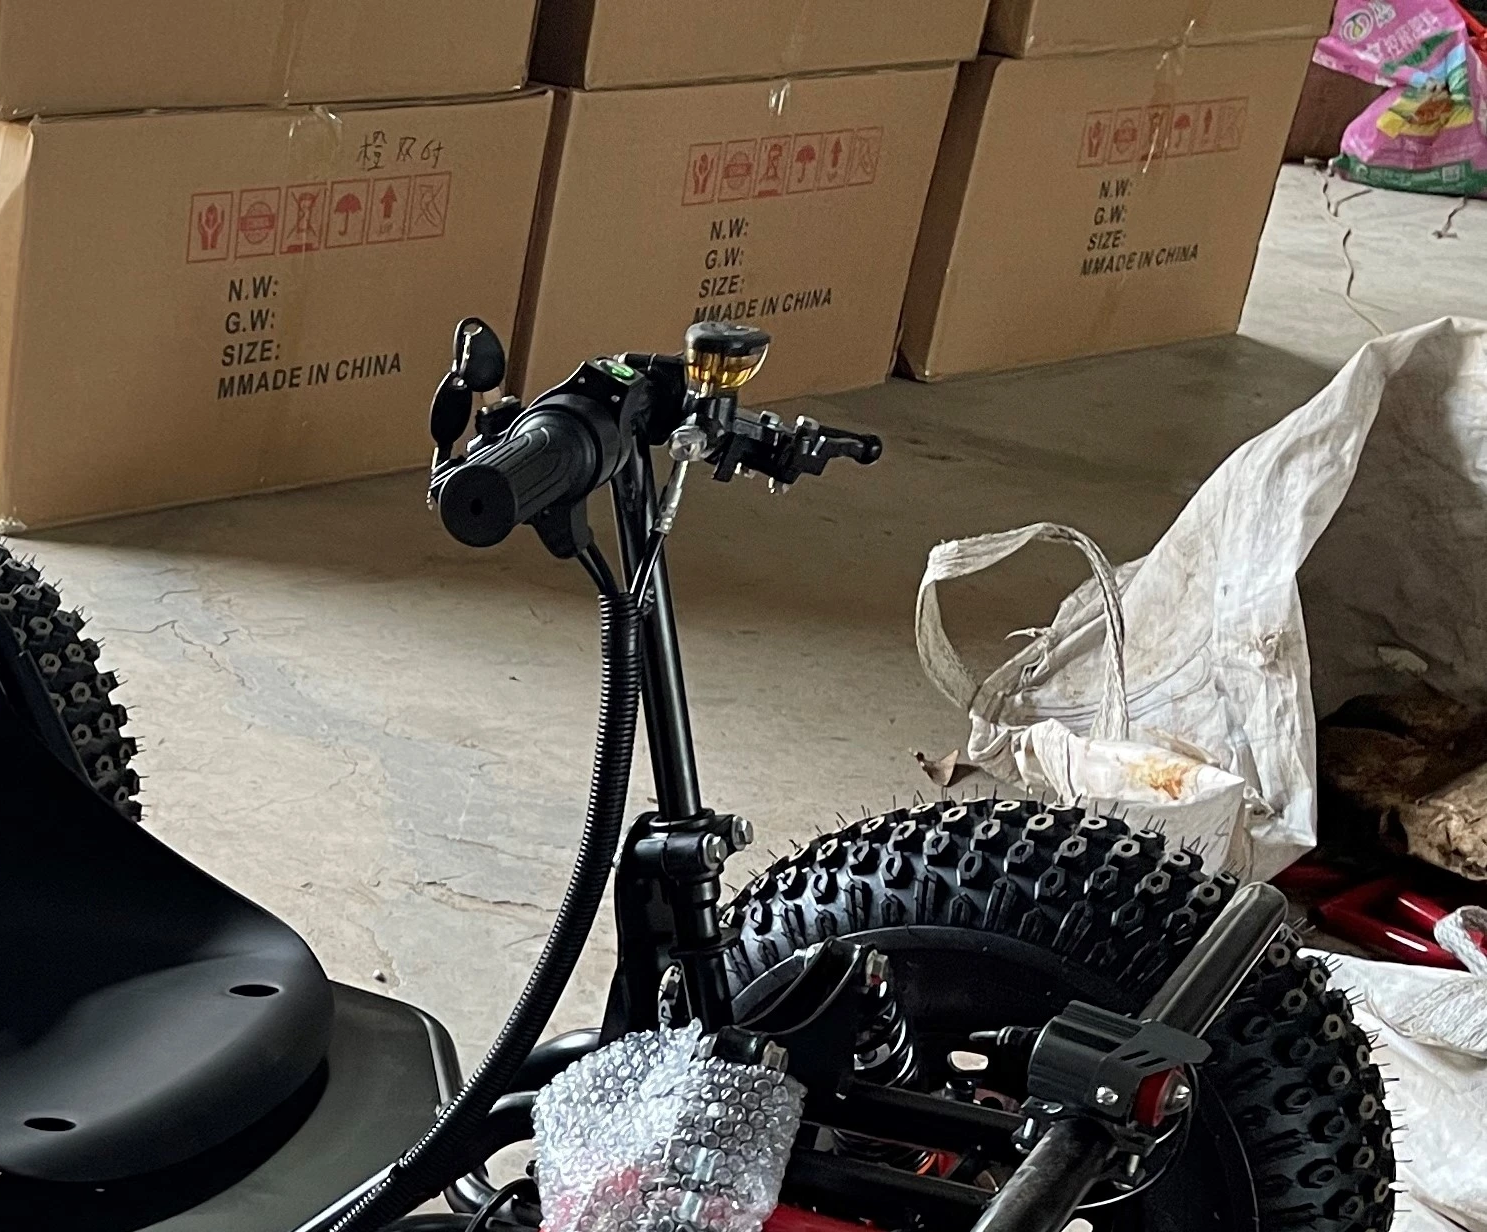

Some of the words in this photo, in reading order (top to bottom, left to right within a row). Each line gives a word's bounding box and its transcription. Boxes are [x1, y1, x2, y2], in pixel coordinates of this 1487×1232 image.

[710, 217, 750, 241] N.W:
[1087, 230, 1127, 252] SIZE:
[704, 247, 744, 270] G.W:
[1080, 252, 1138, 276] MMADE
[1138, 249, 1154, 270] IN
[1155, 243, 1199, 266] CHINA
[228, 275, 280, 302] N.W:
[698, 275, 746, 299] SIZE:
[692, 299, 759, 324] MMADE
[761, 296, 780, 318] IN
[782, 288, 832, 313] CHINA
[224, 308, 276, 335] G.W:
[221, 339, 281, 367] SIZE:
[217, 366, 303, 400] MMADE
[307, 362, 330, 386] IN
[335, 352, 402, 382] CHINA
